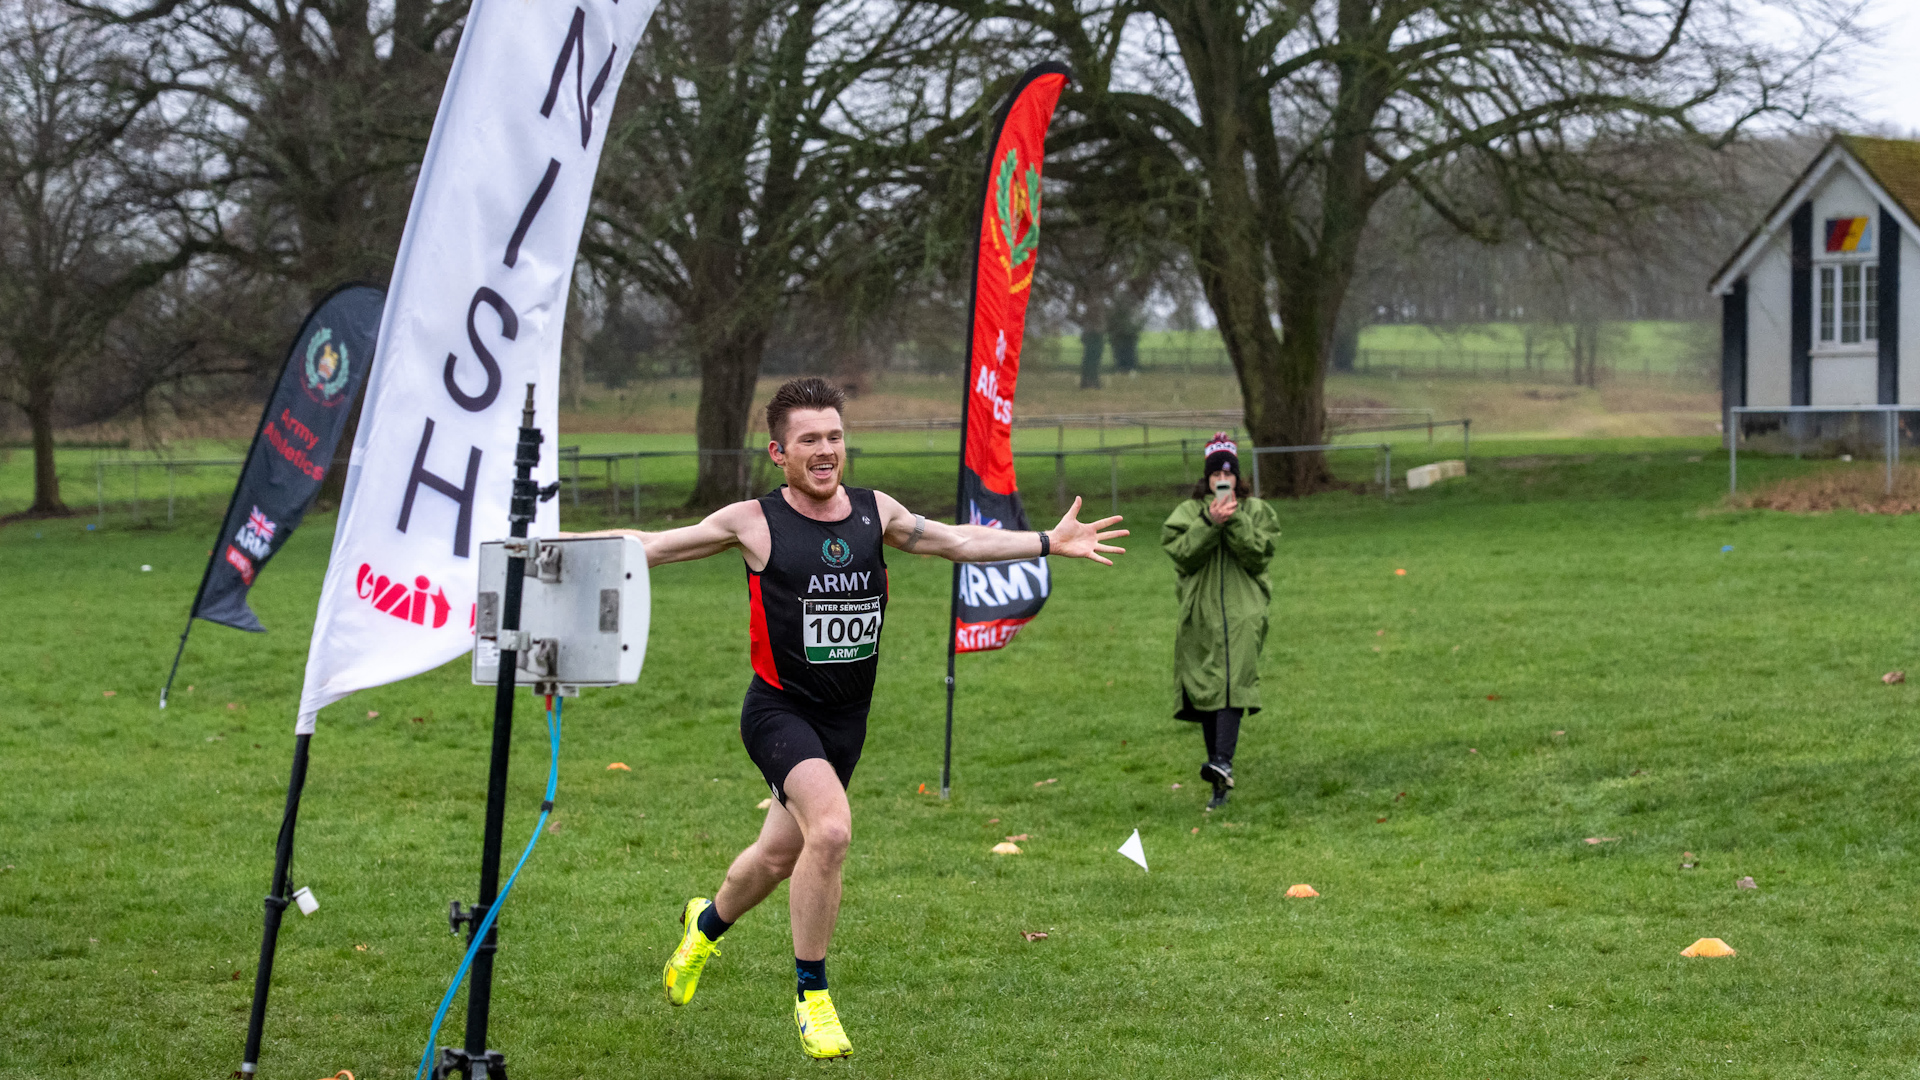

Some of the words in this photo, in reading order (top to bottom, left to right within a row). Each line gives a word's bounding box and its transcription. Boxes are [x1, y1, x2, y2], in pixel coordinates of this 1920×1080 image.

[396, 0, 619, 558] NISH
[281, 408, 319, 450] Army
[263, 421, 324, 481] Athletics
[235, 525, 271, 560] ARM
[807, 571, 871, 593] ARMY
[959, 556, 1049, 607] ARMY
[815, 604, 838, 612] INTER
[839, 602, 871, 612] SERVICES
[809, 615, 877, 644] 1004
[957, 624, 1026, 649] ATHLET
[828, 647, 860, 659] ARMY
